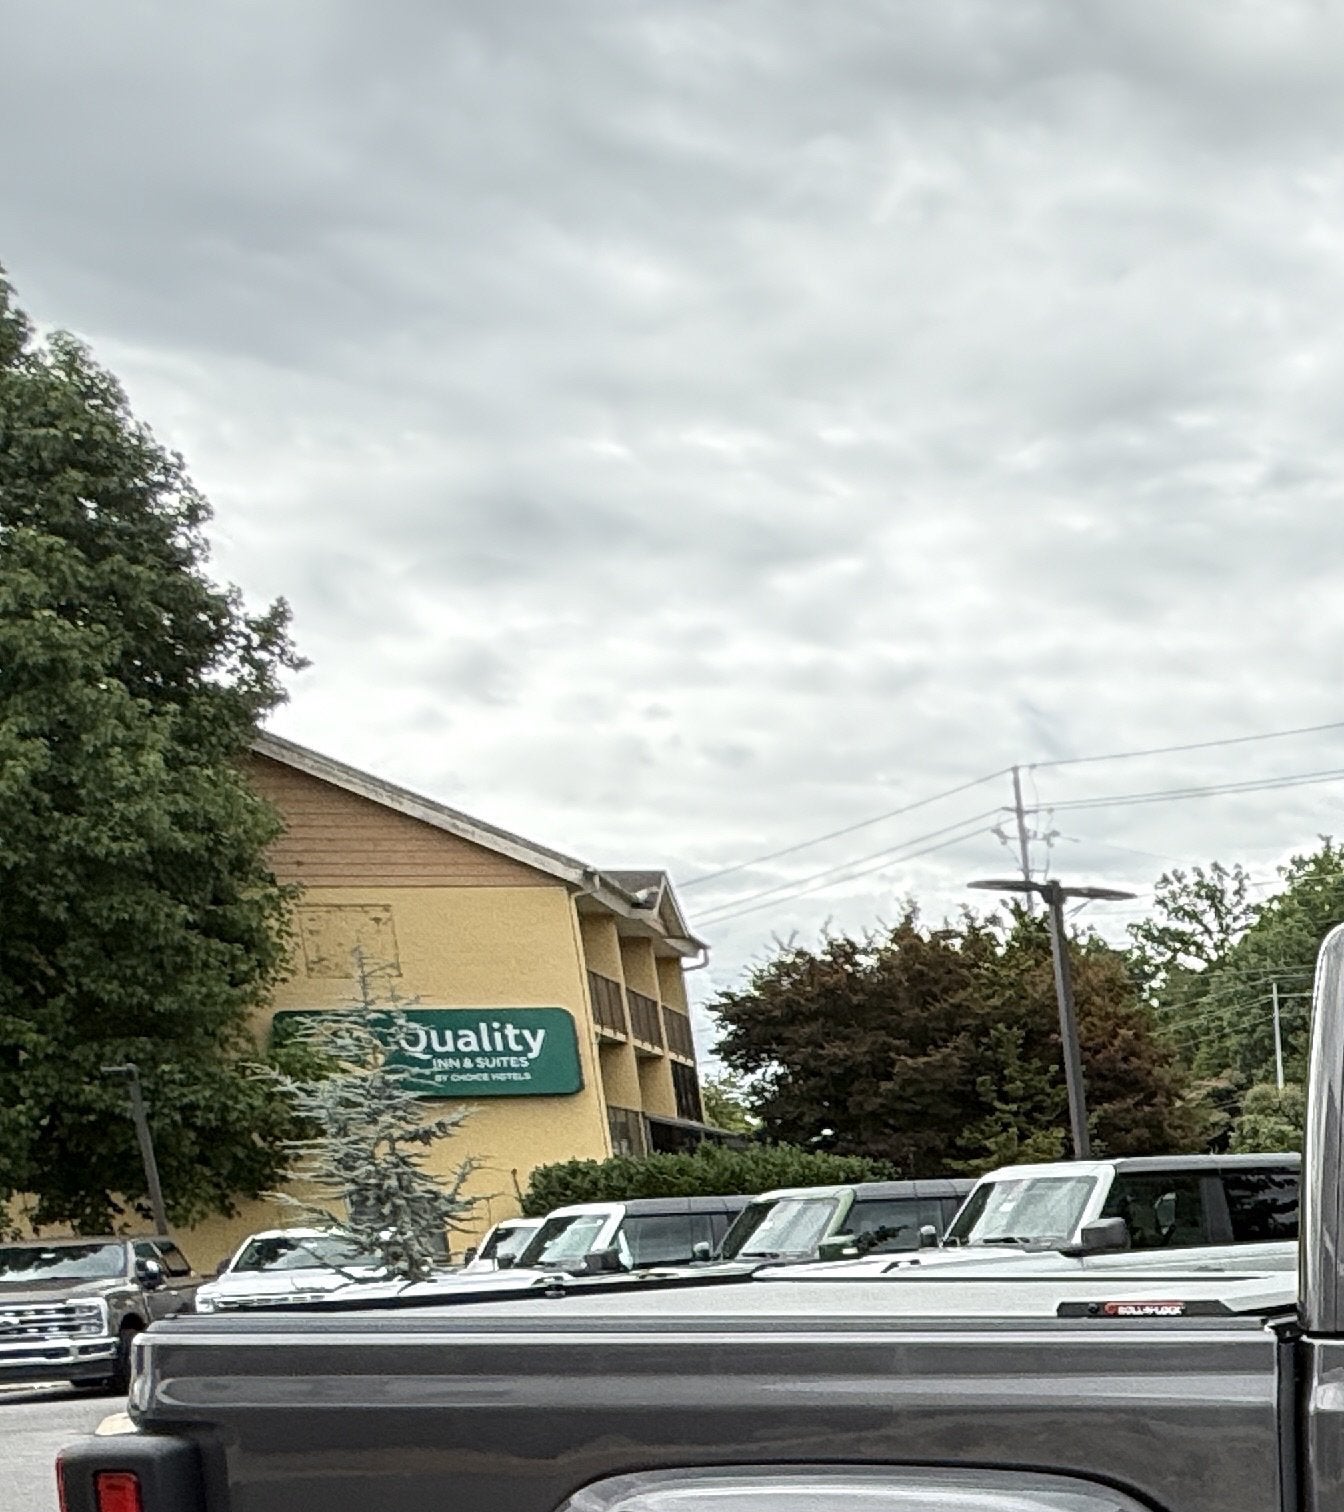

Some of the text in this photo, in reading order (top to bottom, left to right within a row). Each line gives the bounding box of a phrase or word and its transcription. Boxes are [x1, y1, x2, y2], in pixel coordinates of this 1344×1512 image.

[400, 1022, 546, 1060] Quality
[432, 1056, 530, 1070] INN & SUITES
[435, 1072, 532, 1082] BY CHOICE HOTELS
